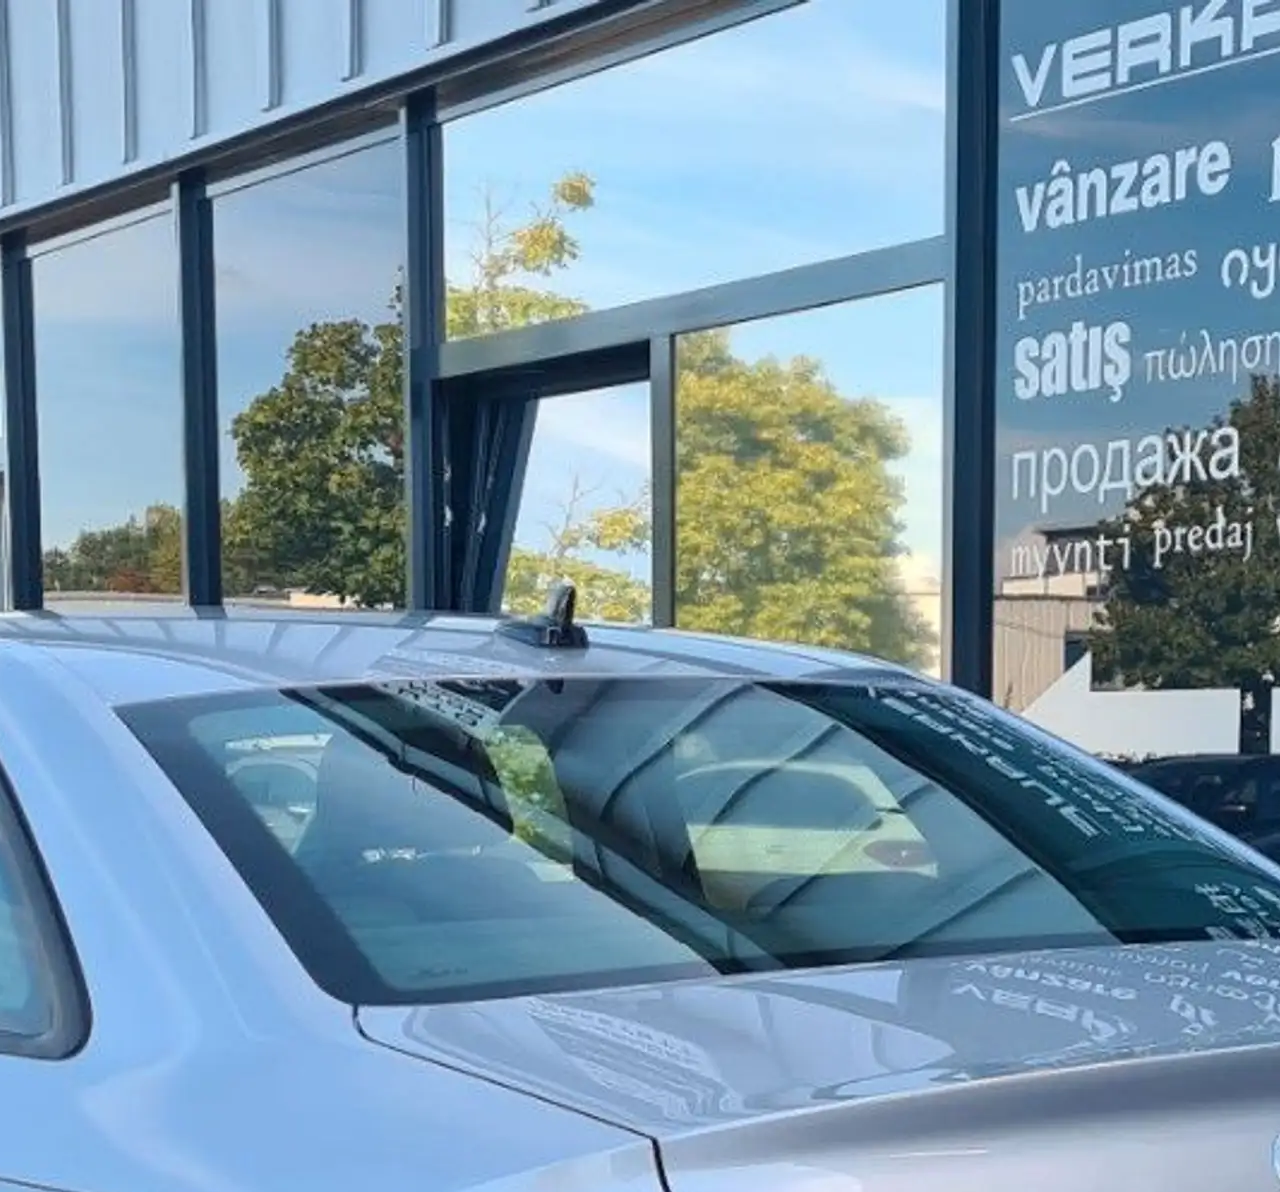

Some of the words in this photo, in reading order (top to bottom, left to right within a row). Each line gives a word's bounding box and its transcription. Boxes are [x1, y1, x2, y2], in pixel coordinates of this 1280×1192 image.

[1016, 140, 1231, 232] vânzare
[1017, 249, 1197, 319] pardavimas
[1014, 321, 1131, 402] satış
[1012, 425, 1241, 513] продажа
[1010, 522, 1132, 580] myynti
[1151, 504, 1254, 569] predaj
